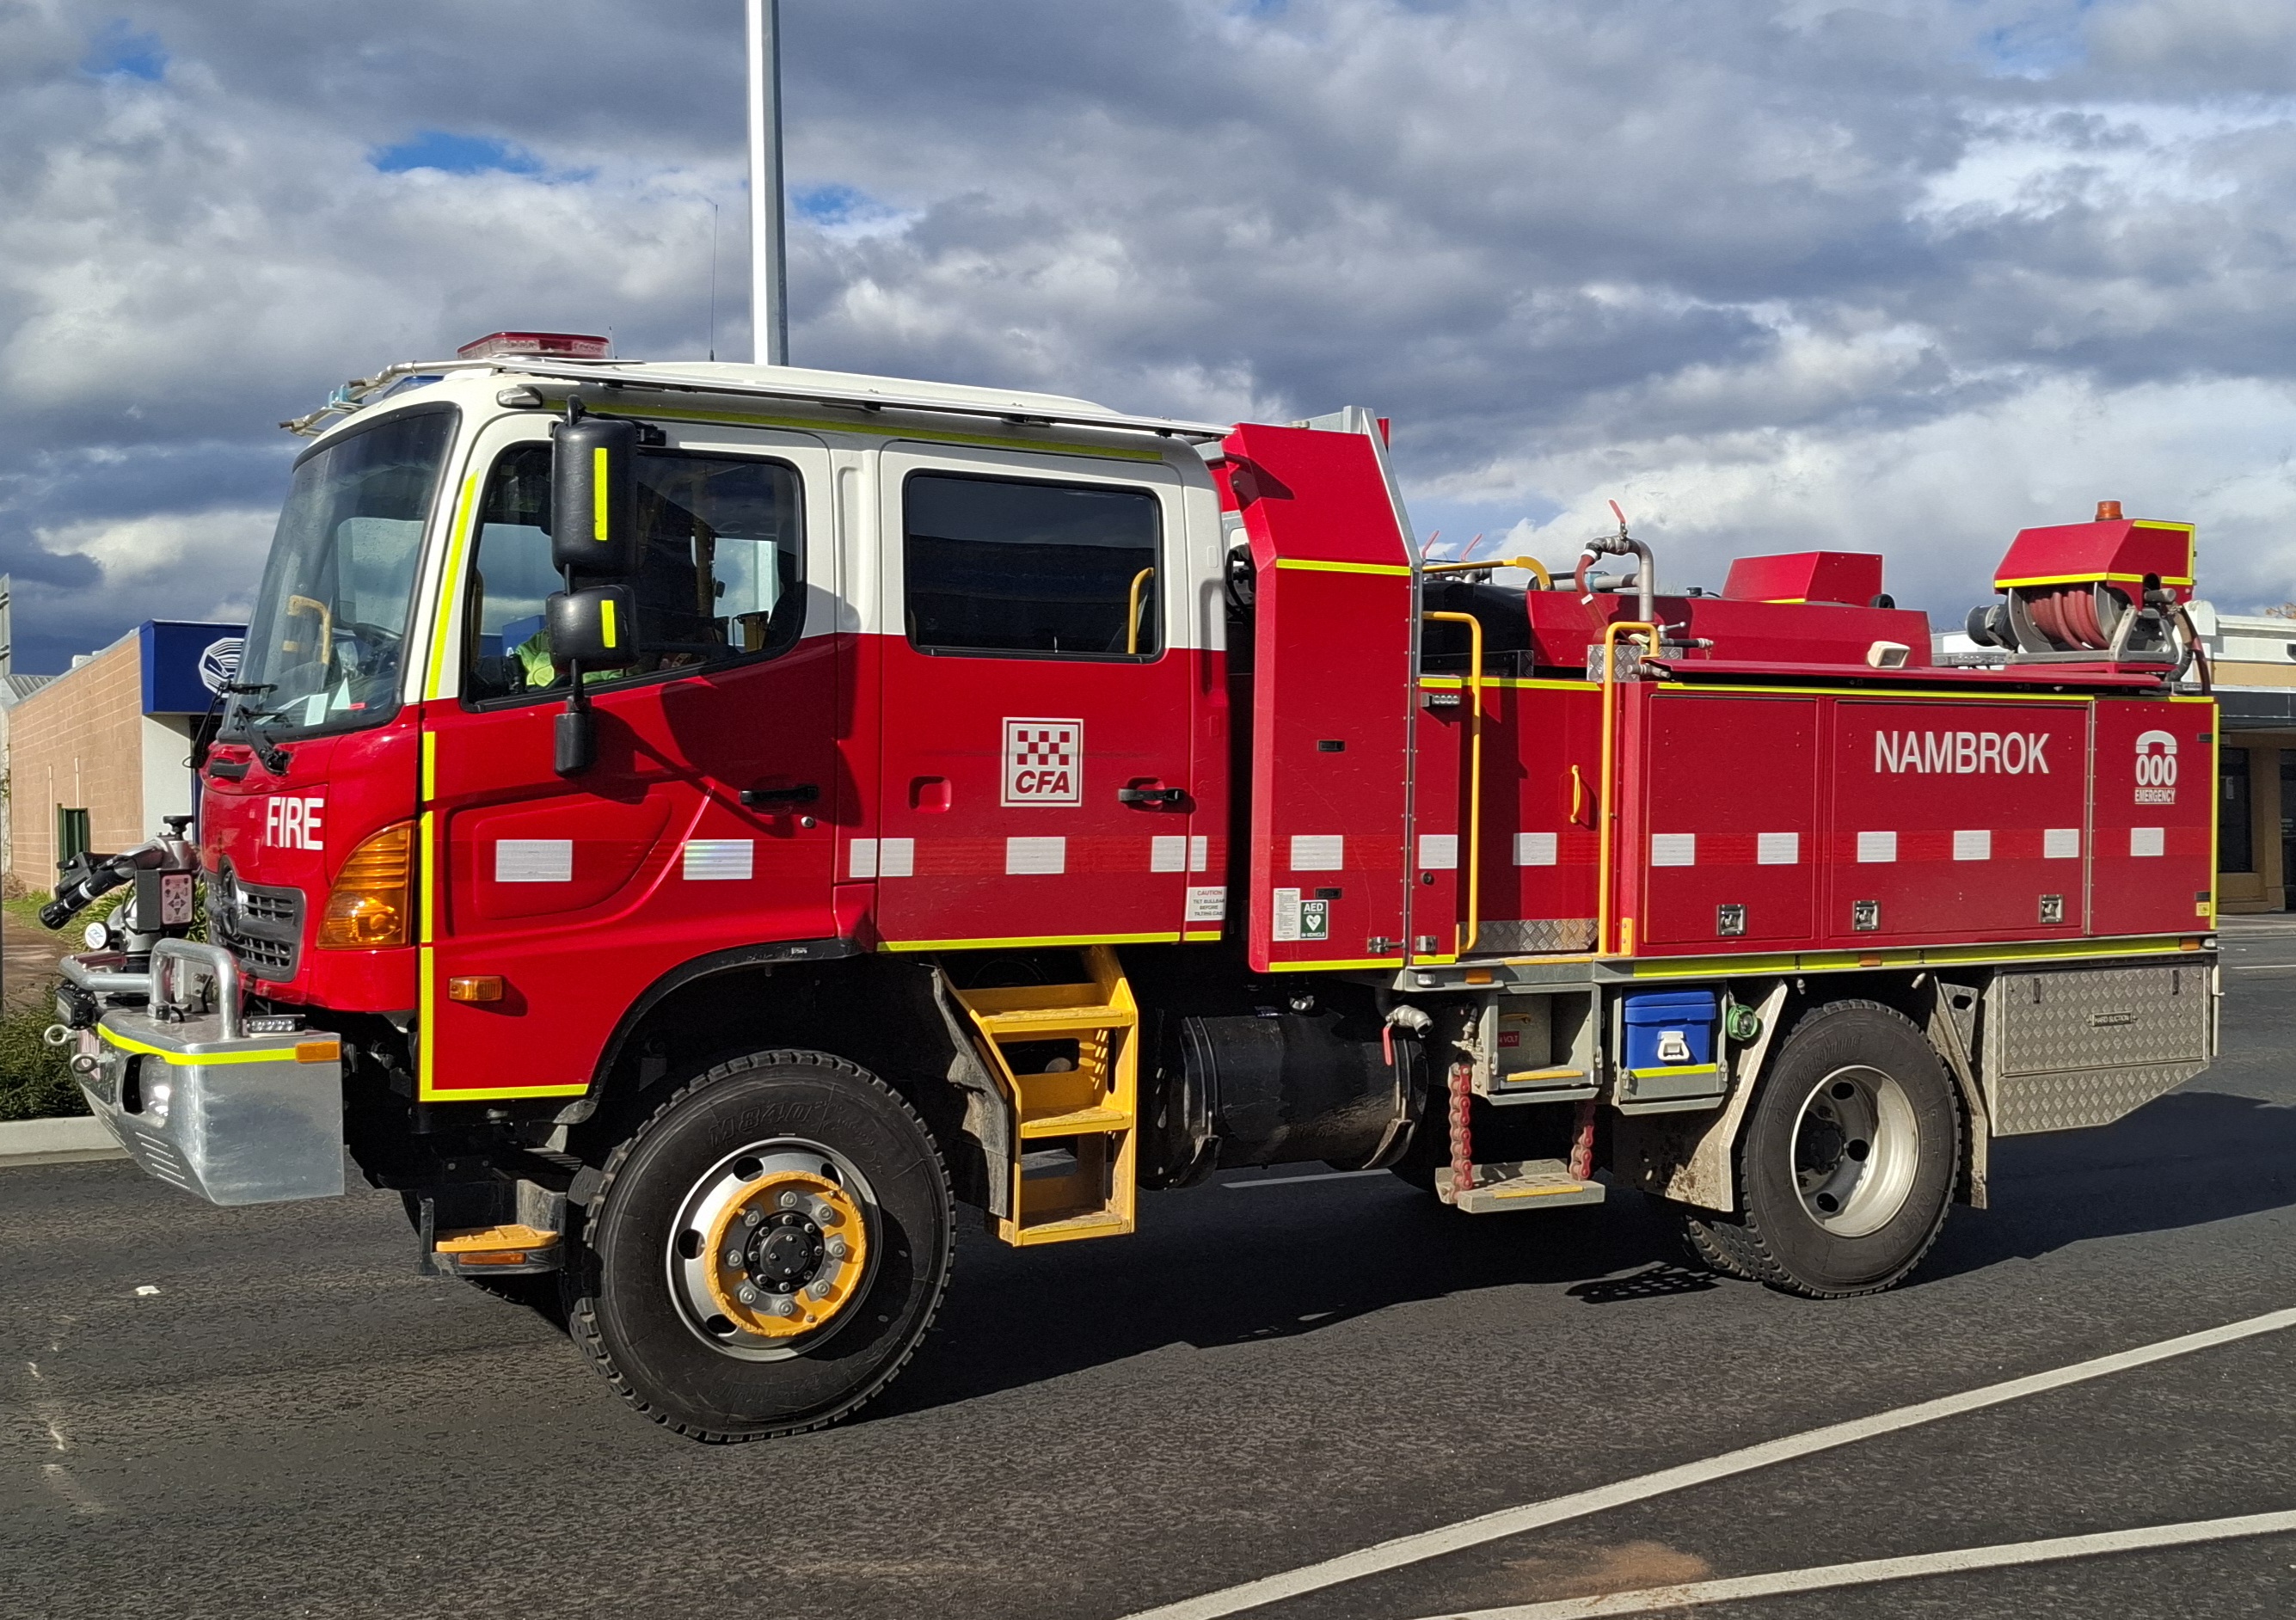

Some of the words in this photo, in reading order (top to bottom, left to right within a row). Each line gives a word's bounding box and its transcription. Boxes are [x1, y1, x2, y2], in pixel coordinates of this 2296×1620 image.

[1875, 730, 2051, 775] NAMBROK
[1015, 770, 1071, 795] CFA
[2135, 754, 2177, 786] 000
[2134, 789, 2176, 803] EMERGENCY
[267, 796, 325, 851] FIRE
[1303, 902, 1324, 912] AED
